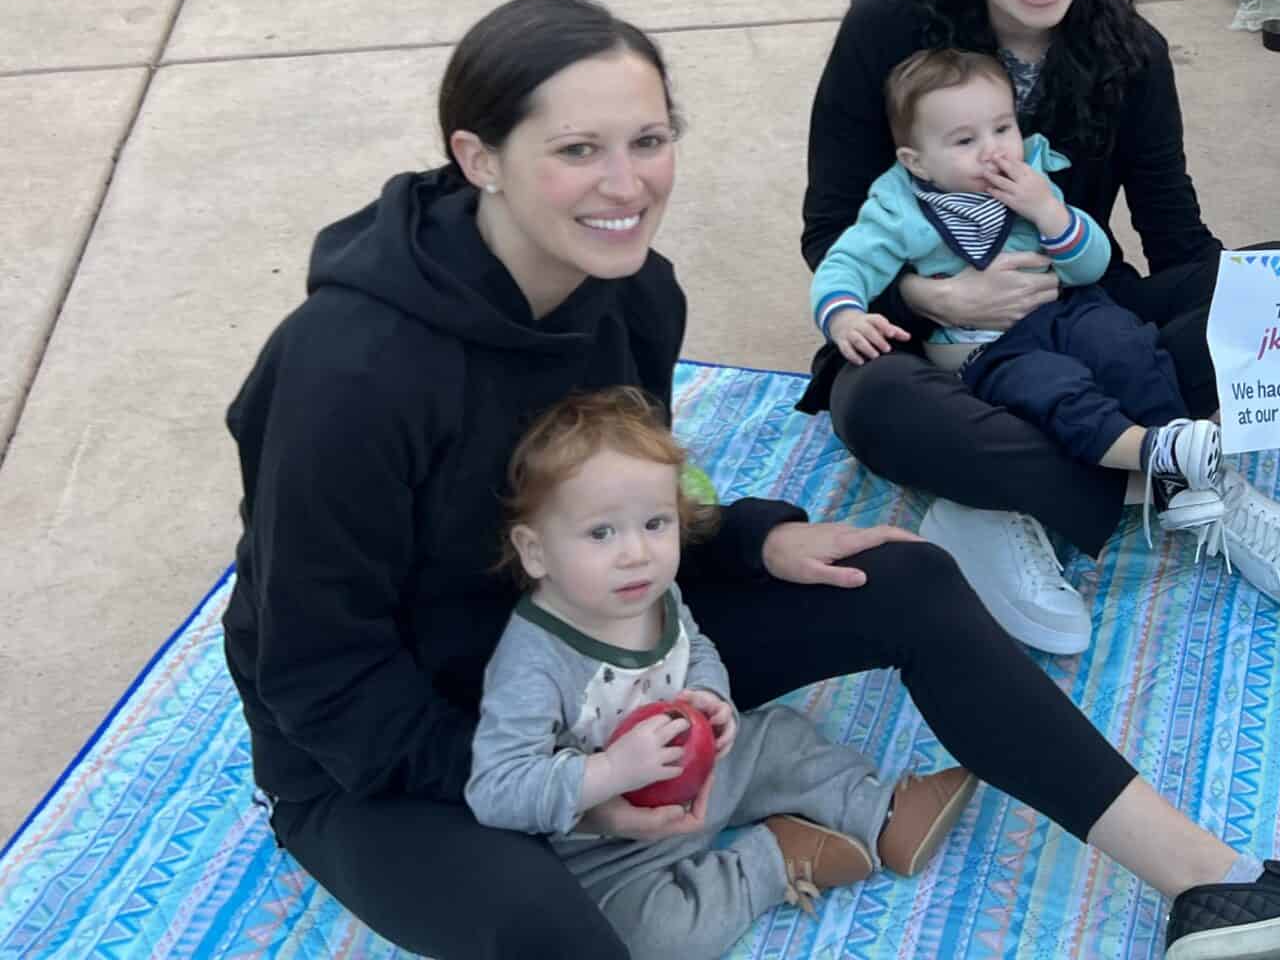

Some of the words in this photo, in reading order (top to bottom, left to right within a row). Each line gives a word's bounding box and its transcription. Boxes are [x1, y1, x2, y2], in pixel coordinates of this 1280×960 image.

[1231, 383, 1254, 400] We
[1238, 408, 1252, 425] at
[1255, 407, 1279, 424] our
